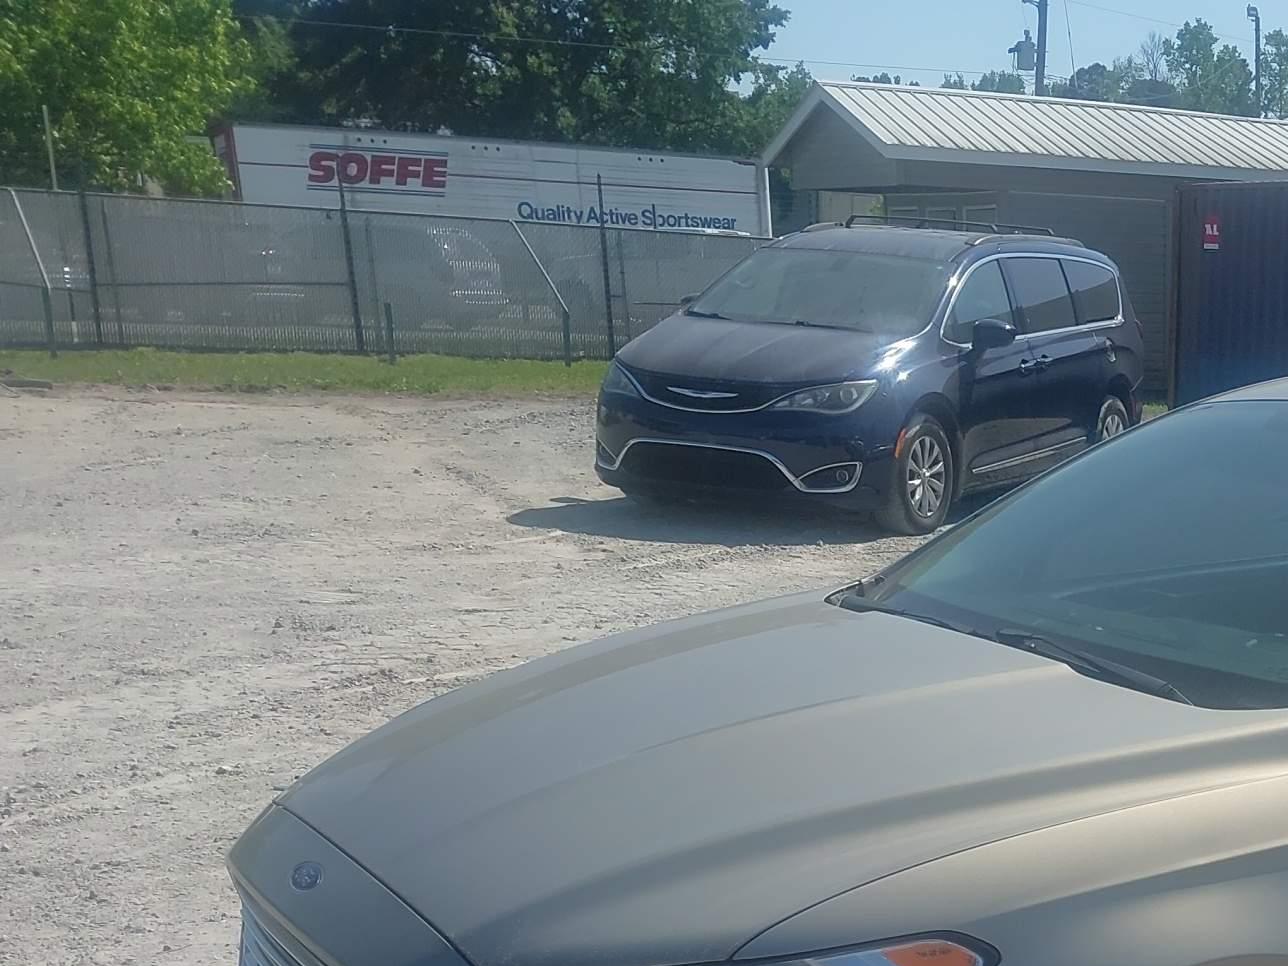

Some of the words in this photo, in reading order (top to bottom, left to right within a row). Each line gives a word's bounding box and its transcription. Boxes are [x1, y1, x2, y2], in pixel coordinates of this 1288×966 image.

[307, 151, 448, 189] SOFFE
[517, 201, 583, 225] Quality
[586, 207, 639, 228] Active
[641, 208, 737, 232] Sportswear
